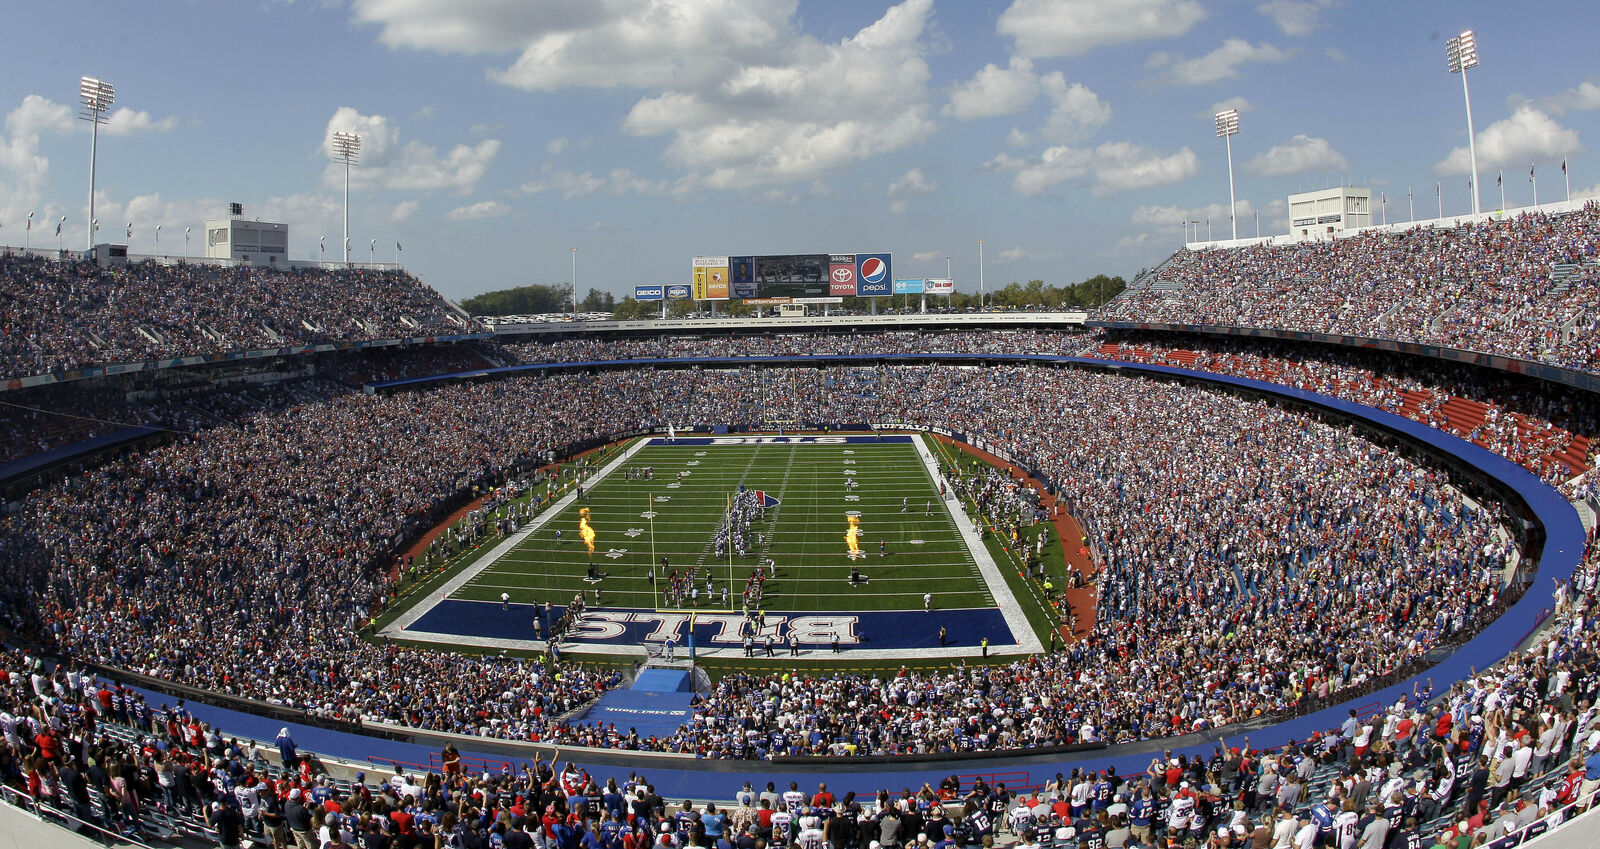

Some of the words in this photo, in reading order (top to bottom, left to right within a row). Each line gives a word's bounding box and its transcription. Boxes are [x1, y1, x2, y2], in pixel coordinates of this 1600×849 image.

[568, 612, 860, 644] BILLS
[774, 738, 784, 746] 78
[960, 740, 968, 748] 78
[1456, 763, 1468, 777] 51
[1097, 789, 1109, 801] 12
[991, 801, 1005, 812] 12
[1139, 807, 1153, 819] 12
[974, 815, 991, 832] 12
